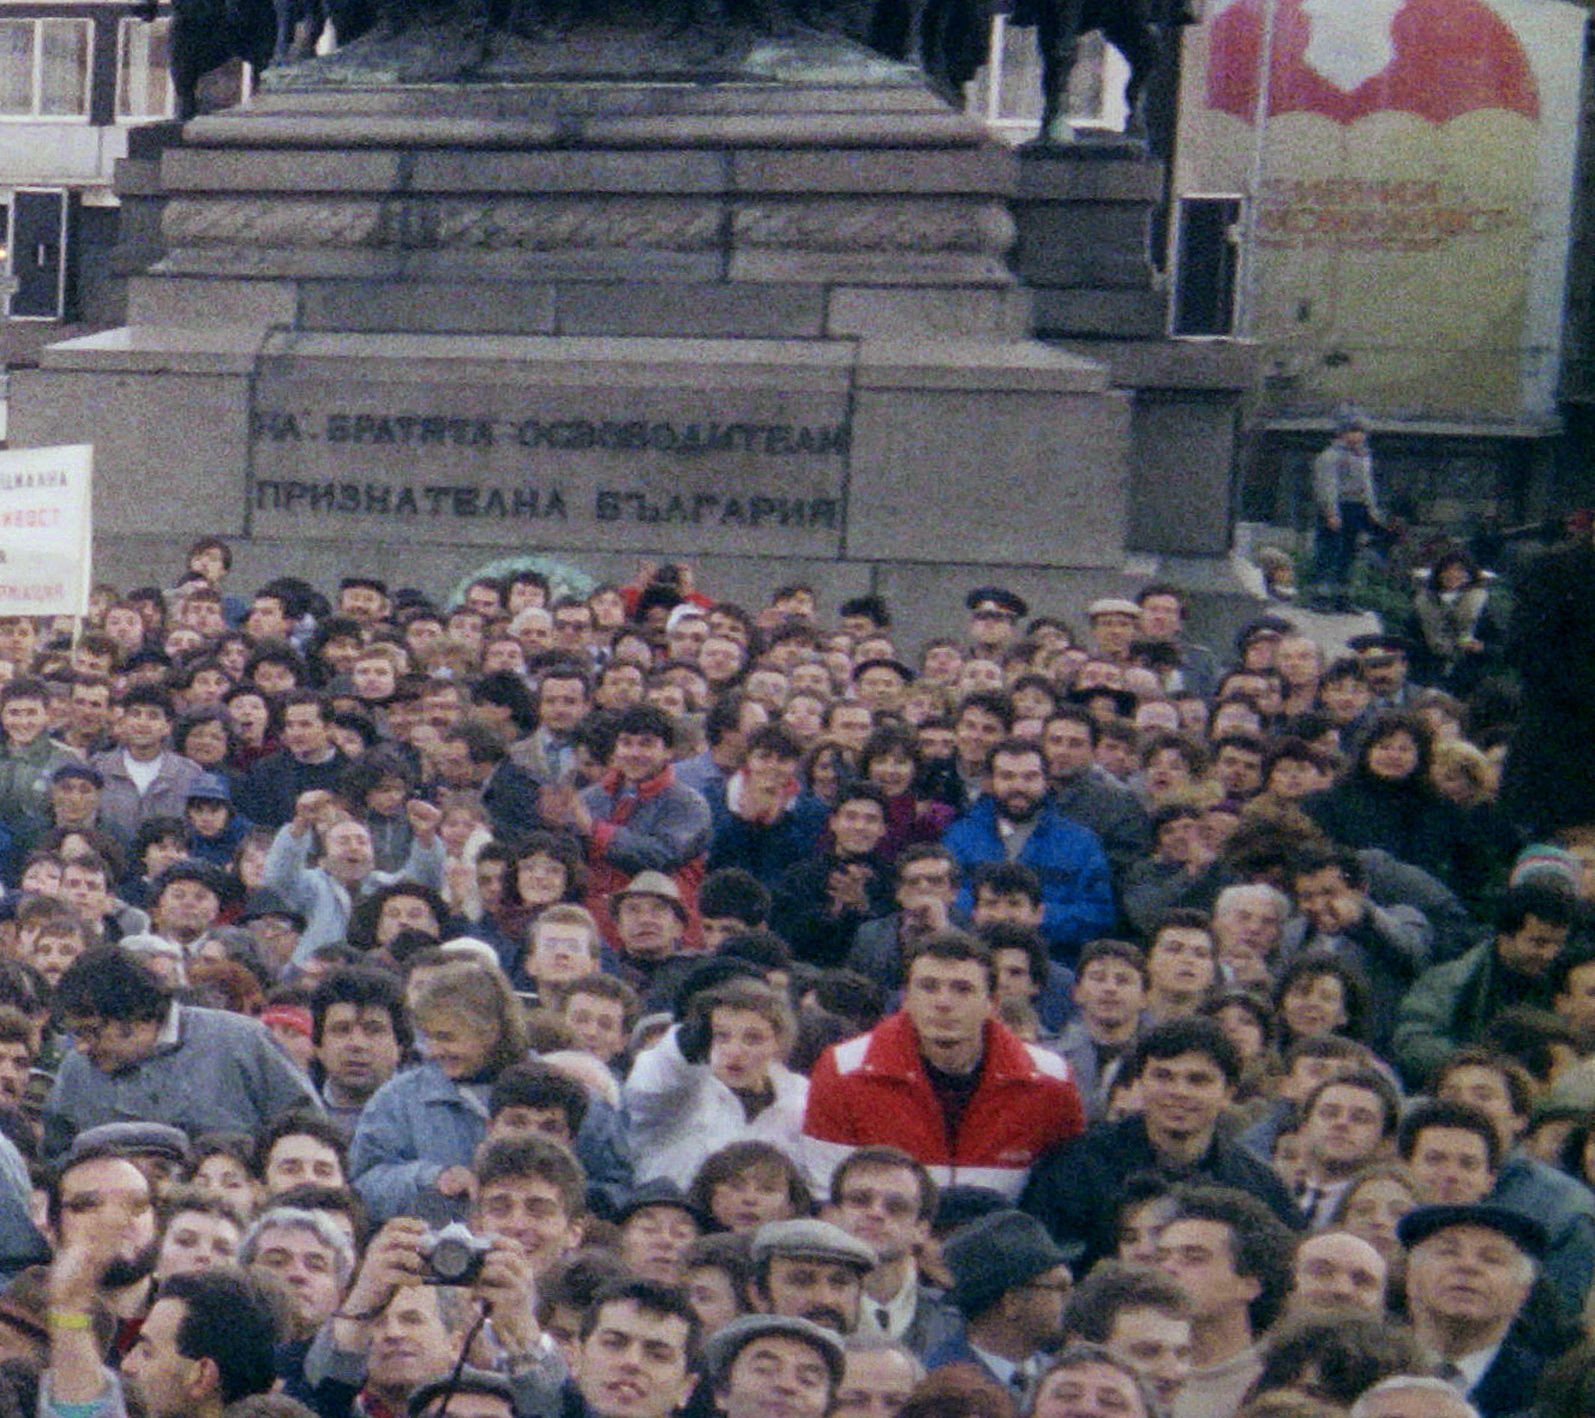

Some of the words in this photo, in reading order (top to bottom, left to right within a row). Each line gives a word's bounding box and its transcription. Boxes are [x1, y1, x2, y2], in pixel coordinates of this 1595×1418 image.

[249, 411, 301, 442] НА
[517, 418, 847, 456] ОСВОБОДИТЕЛИ
[255, 480, 568, 519] ПРИЗНАТЕЛНА
[596, 490, 837, 528] БЪЛГАРИЯ
